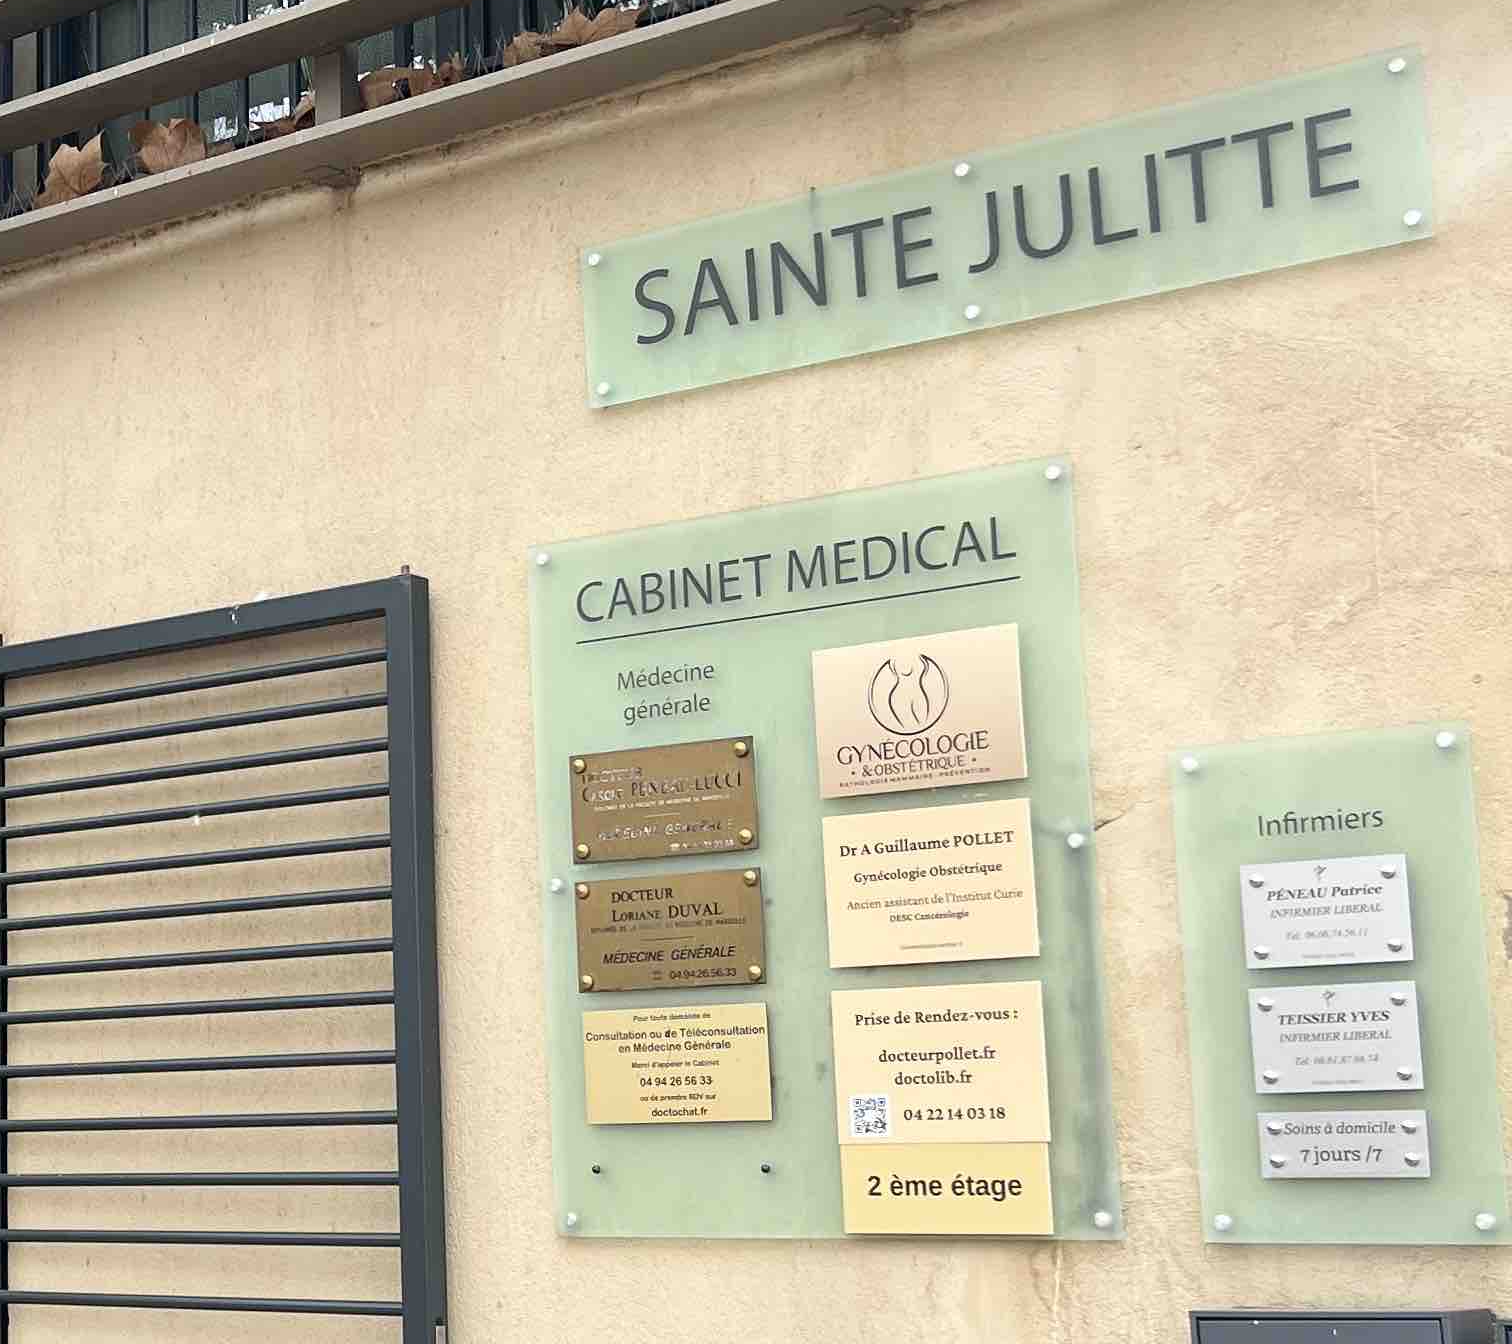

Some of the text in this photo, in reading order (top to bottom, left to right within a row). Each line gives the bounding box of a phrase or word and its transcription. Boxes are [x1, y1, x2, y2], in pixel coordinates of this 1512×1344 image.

[634, 107, 1361, 346] SAINTE JULITTE
[576, 516, 1018, 623] CABINET MEDICAL
[617, 663, 715, 691] Médecine
[623, 693, 712, 727] générale
[1257, 808, 1384, 837] Infirmiers
[840, 830, 1015, 857] Dr A Guillaume POLLET
[854, 861, 1003, 885] Gynécologie Obstétrique
[611, 887, 674, 904] DOCTEUR
[668, 902, 724, 919] DUVAL
[602, 943, 737, 965] MÉDECINE GÉNÉRALE
[855, 1012, 890, 1026] Prise
[894, 1011, 911, 1024] de
[915, 1008, 1010, 1024] Rendez-vous
[1278, 1010, 1391, 1025] TEISSIER YVES
[586, 1029, 647, 1042] Consultation
[664, 1029, 678, 1038] de
[618, 1045, 631, 1053] en
[878, 1046, 996, 1064] docteurpollet.fr
[640, 1075, 712, 1087] 04 94 26 56 33
[894, 1070, 973, 1085] doctolib.fr
[903, 1106, 1006, 1121] 04 22 14 03 18
[1283, 1122, 1322, 1136] Soins
[1336, 1120, 1396, 1135] domicile
[1313, 1145, 1362, 1165] jours
[867, 1173, 1023, 1202] 2 ème étage
